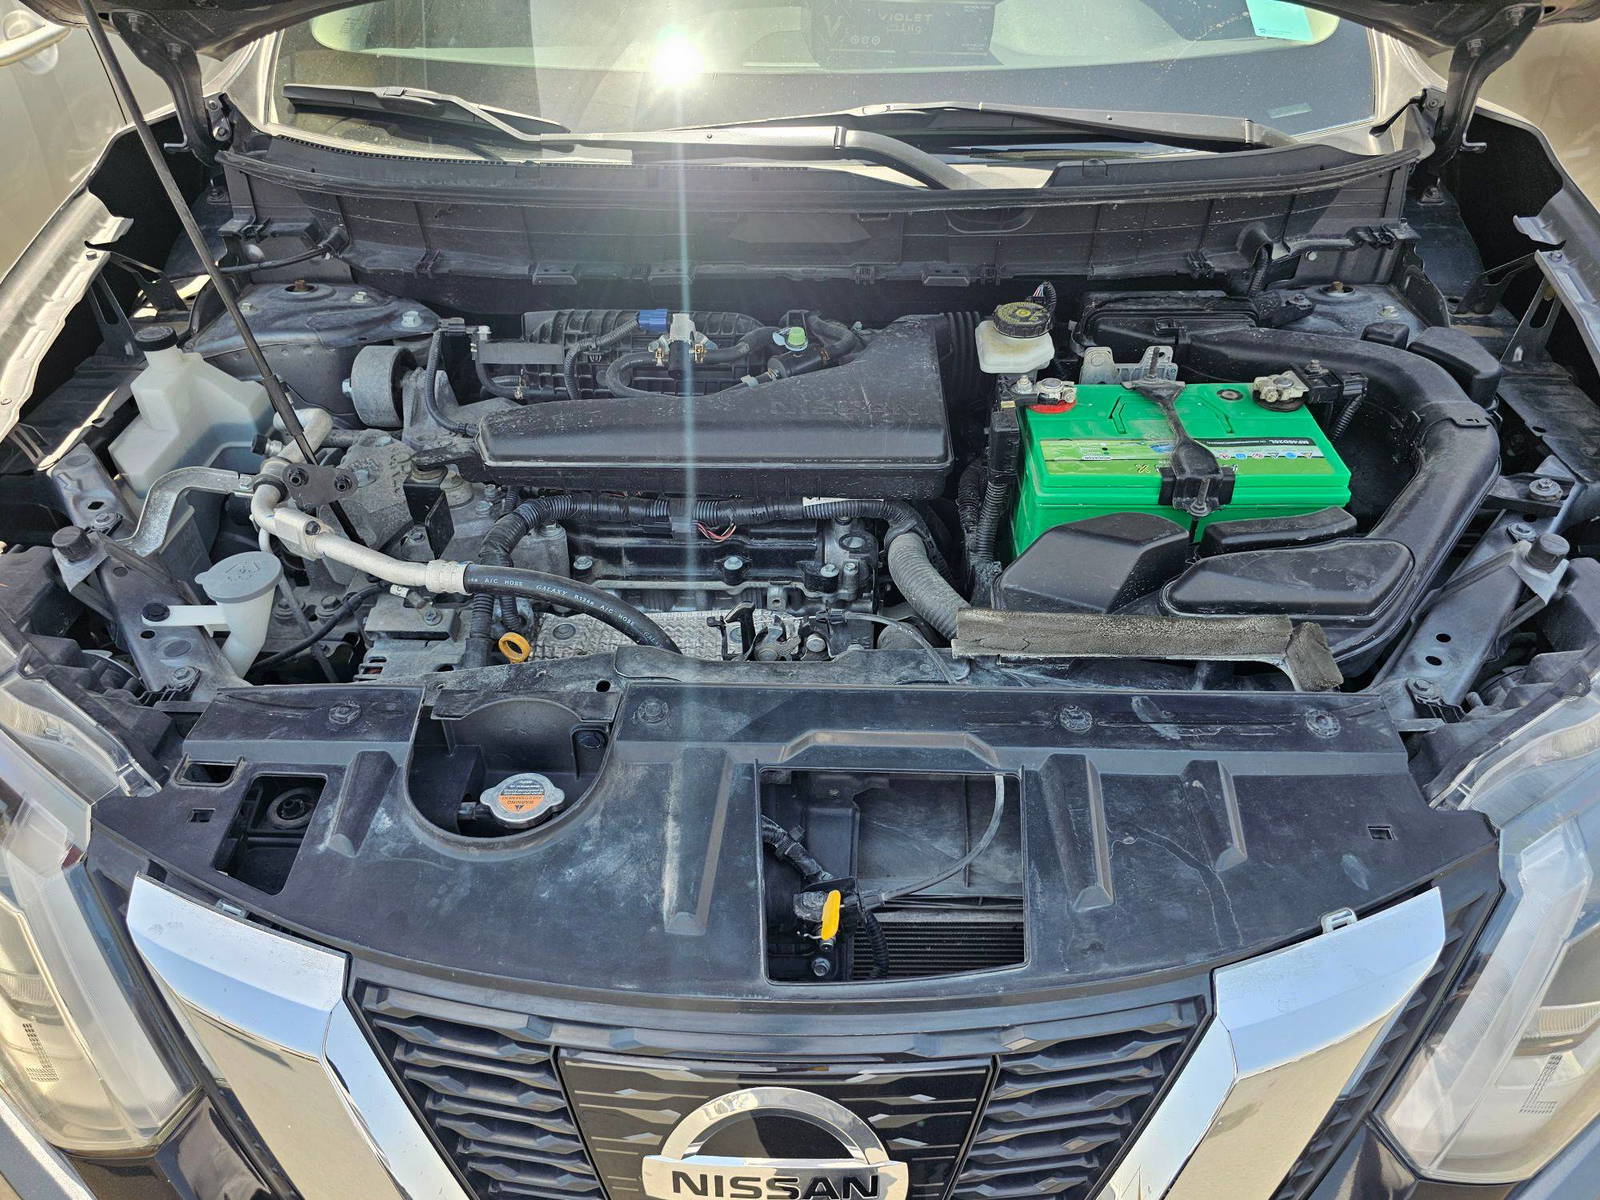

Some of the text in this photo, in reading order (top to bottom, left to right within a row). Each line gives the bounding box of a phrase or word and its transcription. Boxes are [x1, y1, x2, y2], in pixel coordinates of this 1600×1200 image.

[878, 13, 933, 22] VIOLET
[484, 577, 499, 585] A/C
[536, 584, 568, 597] GALAXY
[600, 604, 615, 615] A/C
[672, 1171, 878, 1199] NISSAN
